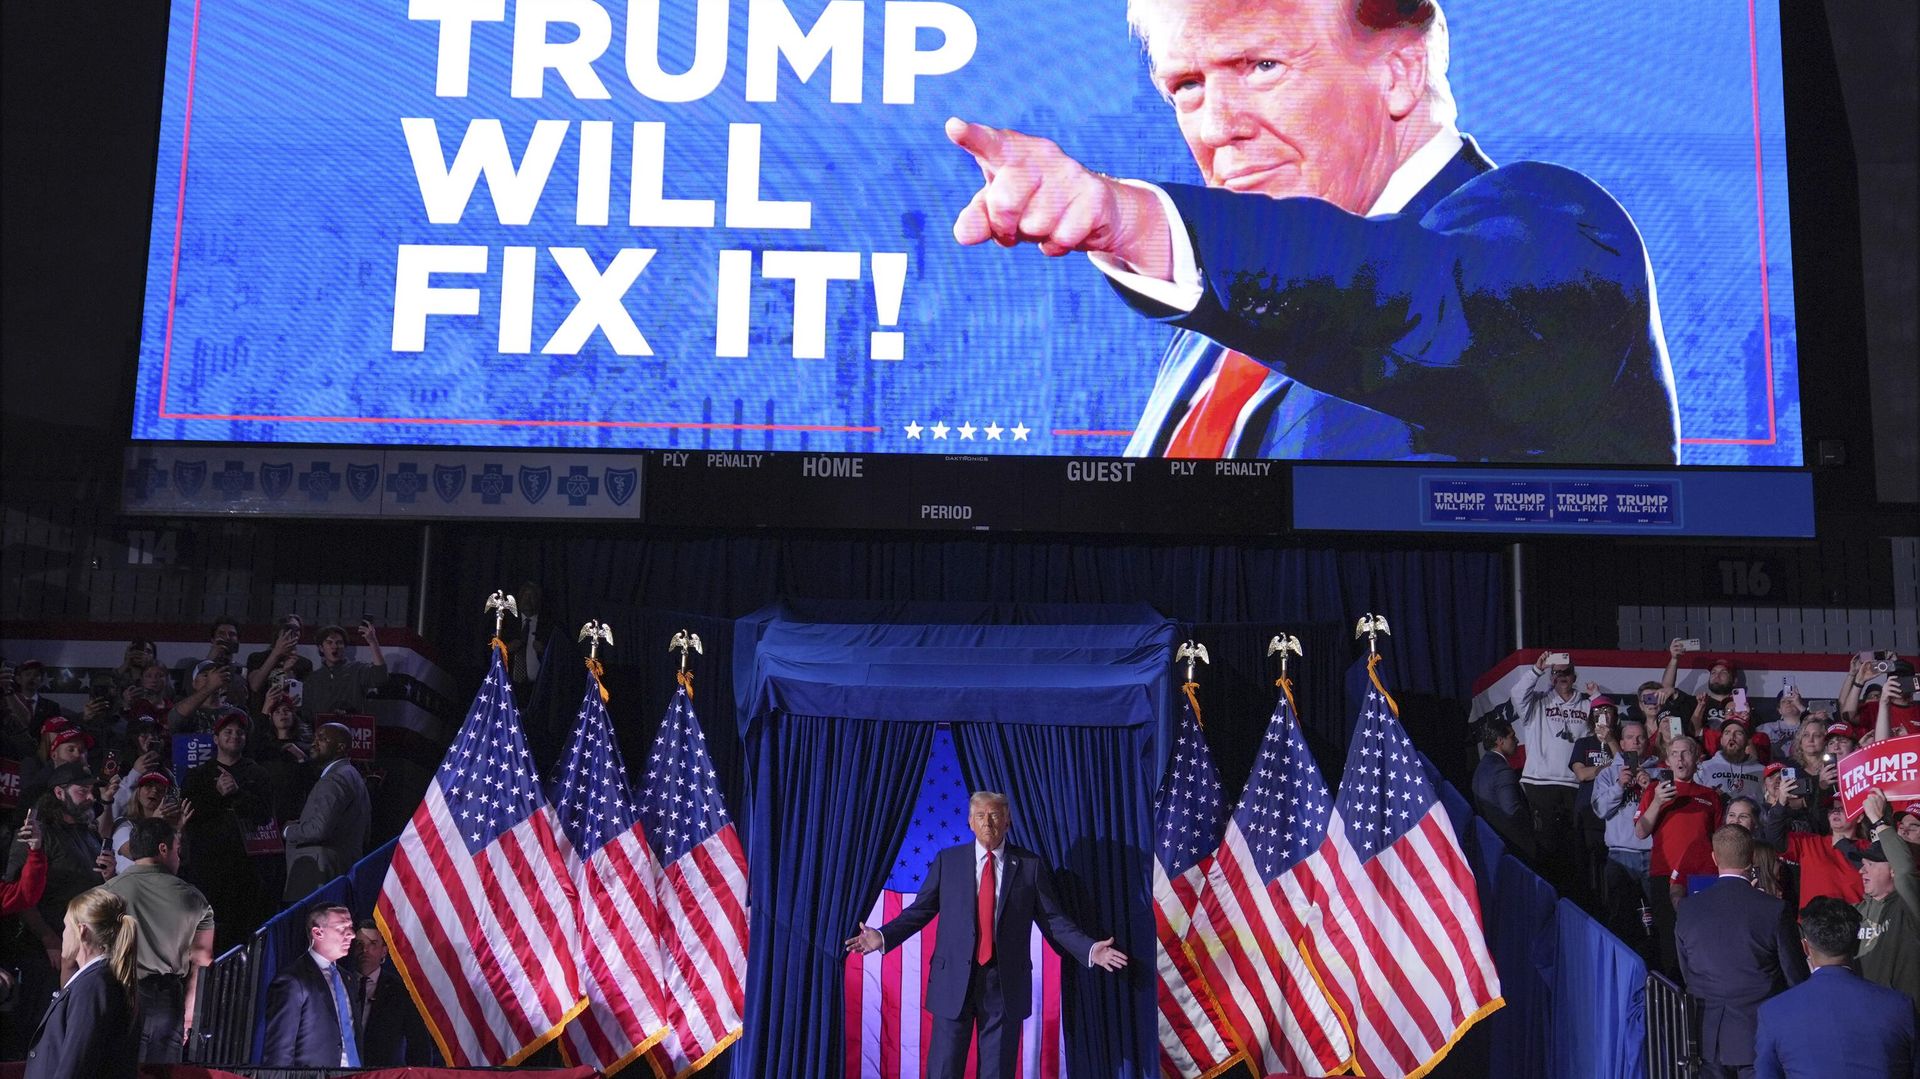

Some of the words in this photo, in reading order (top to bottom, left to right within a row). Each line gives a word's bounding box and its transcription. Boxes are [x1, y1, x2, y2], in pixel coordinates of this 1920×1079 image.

[408, 0, 978, 104] TRUMP
[400, 117, 812, 230] WILL
[391, 244, 658, 357] FIX
[715, 249, 909, 361] IT!
[662, 453, 690, 468] PLY
[707, 453, 763, 468] PENALTY
[802, 456, 864, 478] HOME
[1067, 460, 1136, 483] GUEST
[1170, 461, 1198, 476] PLY
[1215, 461, 1272, 477] PENALTY
[1434, 492, 1486, 504] TRUMP
[1493, 493, 1546, 505] TRUMP
[1556, 493, 1608, 505] TRUMP
[1616, 494, 1669, 506] TRUMP
[921, 504, 972, 519] PERIOD
[1434, 503, 1458, 511] WILL
[1459, 503, 1475, 511] FIX
[1476, 503, 1486, 511] IT
[1494, 503, 1518, 512] WILL
[1519, 504, 1535, 512] FIX
[1536, 504, 1546, 512] IT
[1557, 504, 1581, 512] WILL
[1582, 505, 1598, 513] FIX
[1599, 505, 1608, 513] IT
[1617, 505, 1641, 513] WILL
[1642, 506, 1657, 514] FIX
[1659, 506, 1669, 514] IT
[1719, 560, 1772, 596] 116
[1711, 771, 1760, 783] COLDWATER
[1842, 752, 1918, 789] TRUMP
[1844, 779, 1870, 801] WILL
[1872, 771, 1898, 785] FIX
[1902, 769, 1918, 781] IT
